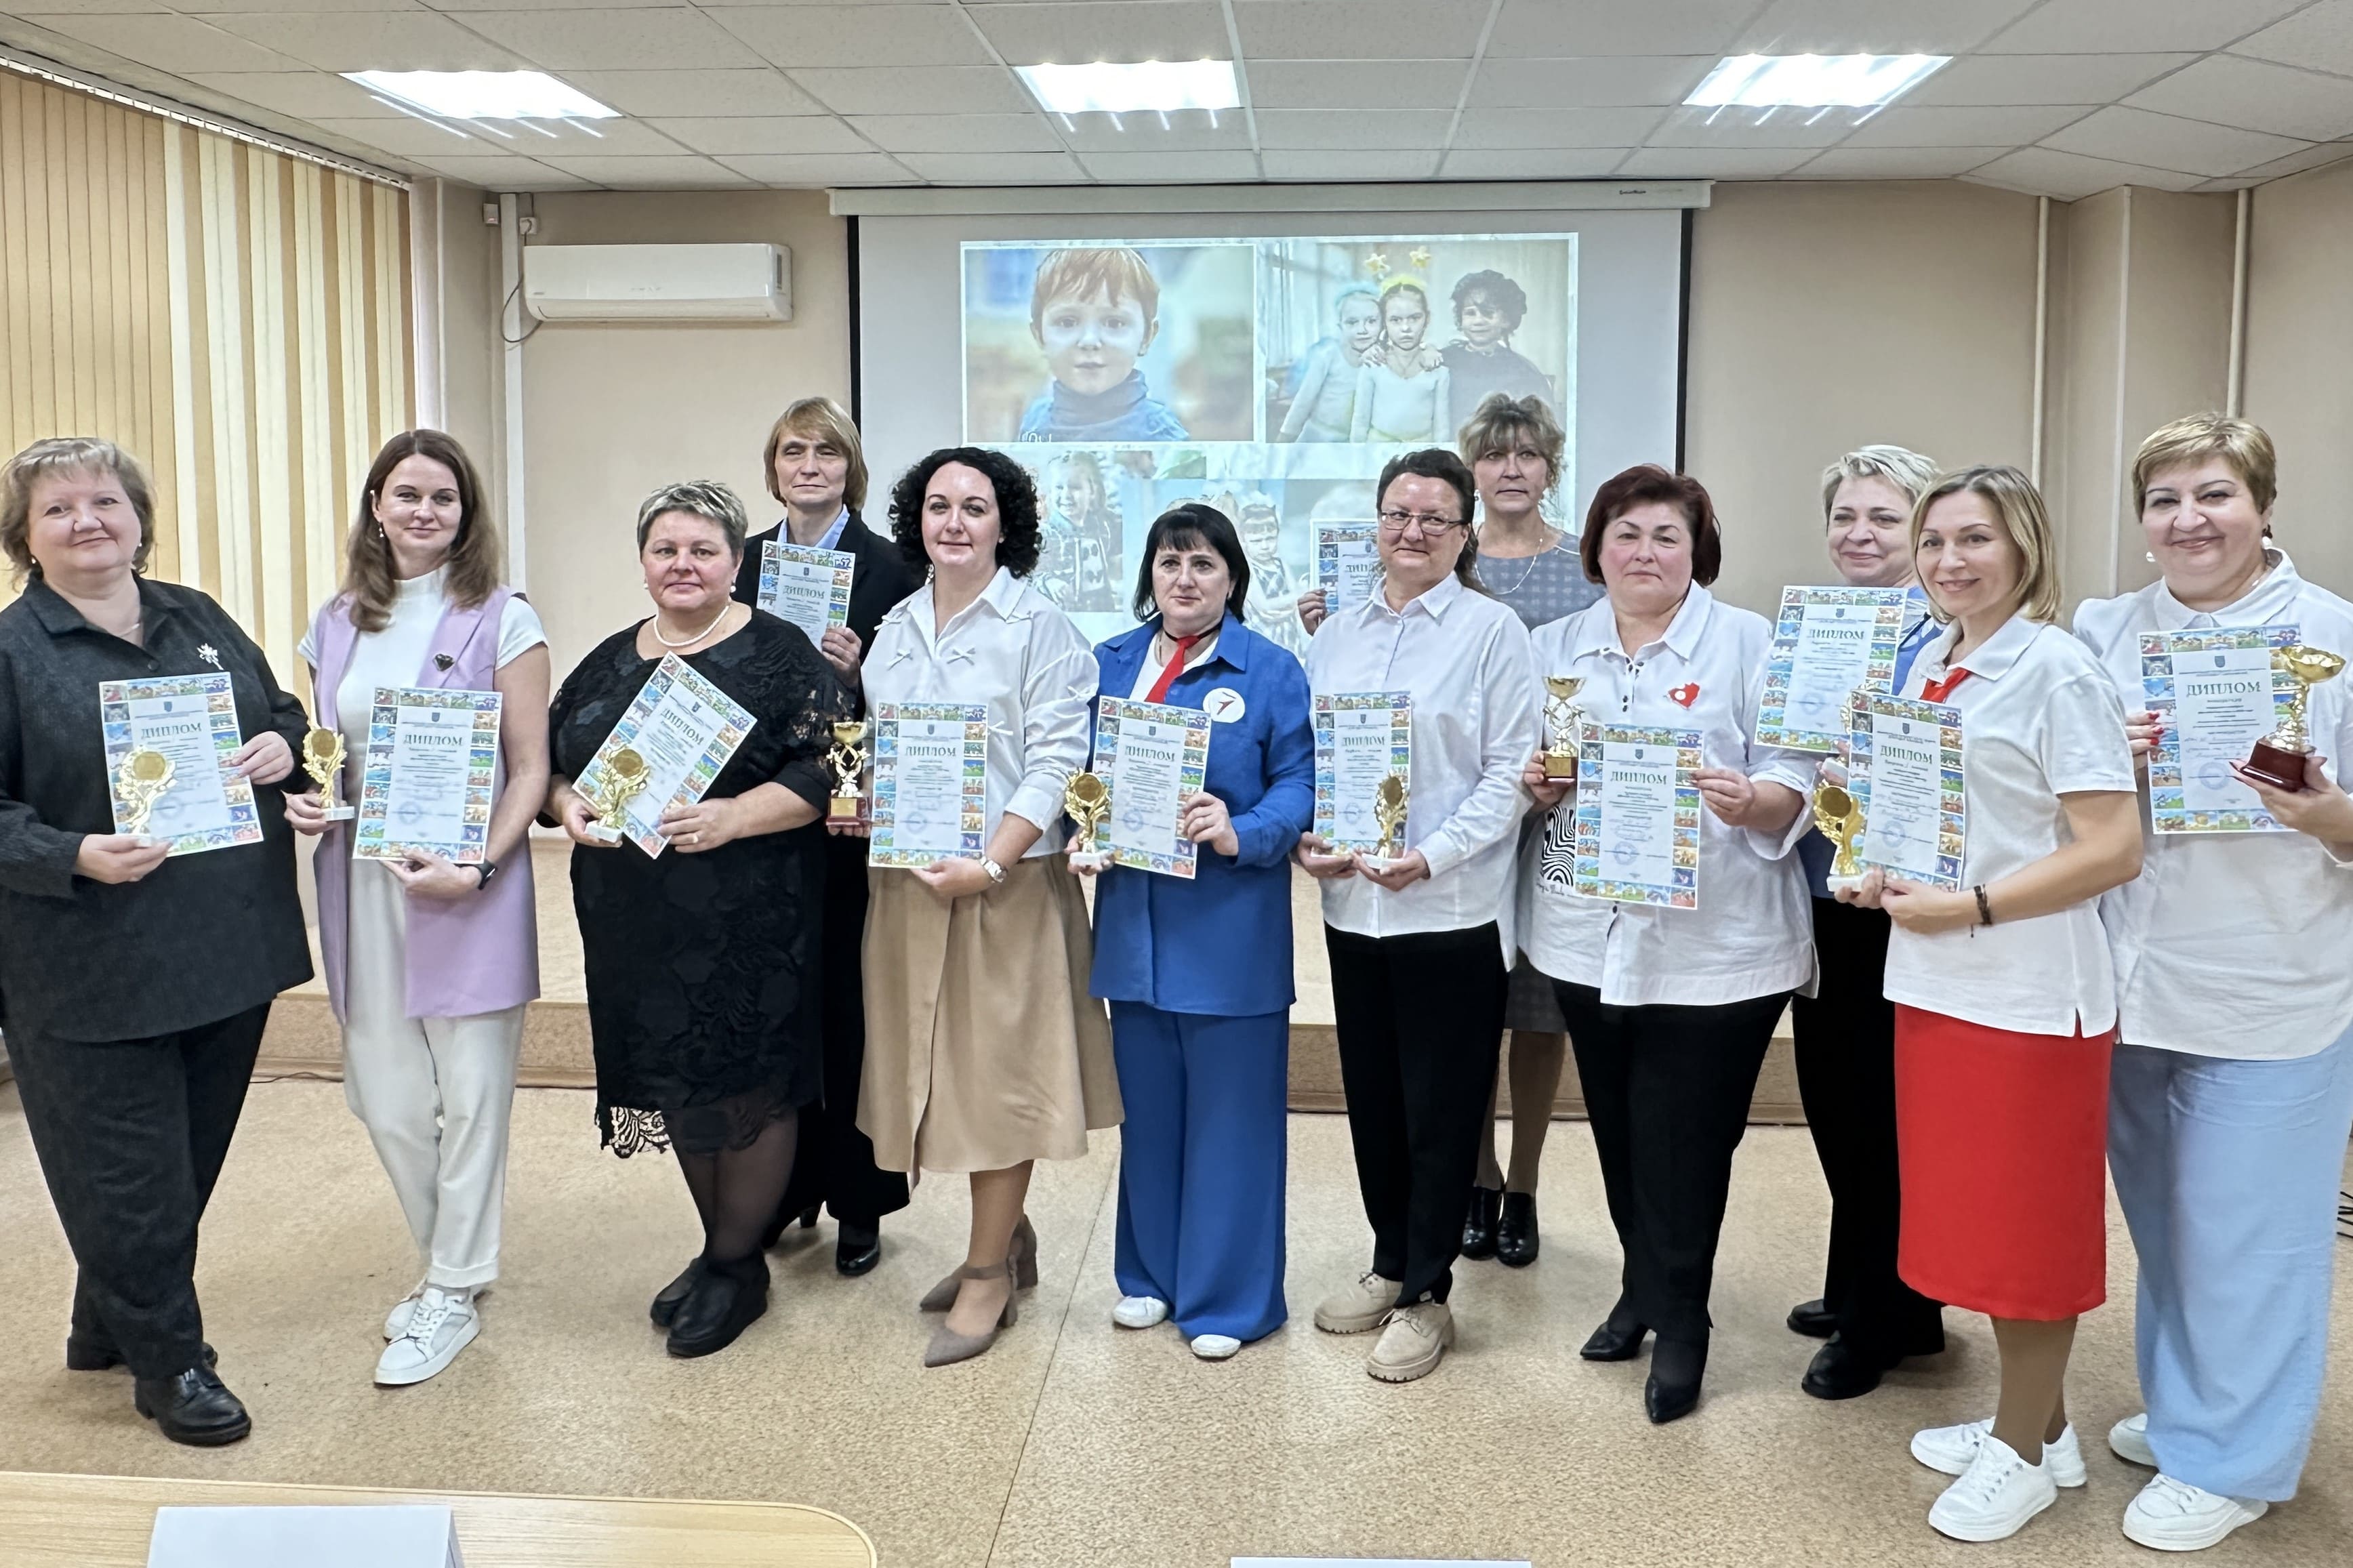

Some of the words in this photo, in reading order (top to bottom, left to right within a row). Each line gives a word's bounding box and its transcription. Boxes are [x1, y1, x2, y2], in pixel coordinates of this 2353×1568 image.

[783, 585, 825, 599] ДИПЛОМ
[1806, 629, 1864, 640] ДИПЛОМ
[2186, 682, 2261, 697] ДИПЛОМ
[140, 722, 202, 739] ДИПЛОМ
[662, 708, 705, 745] ДИПЛОМ
[403, 734, 464, 746] ДИПЛОМ
[905, 746, 956, 757] ДИПЛОМ
[1125, 745, 1175, 762] ДИПЛОМ
[1880, 745, 1933, 764] ДИПЛОМ
[1610, 770, 1667, 785] ДИПЛОМ
